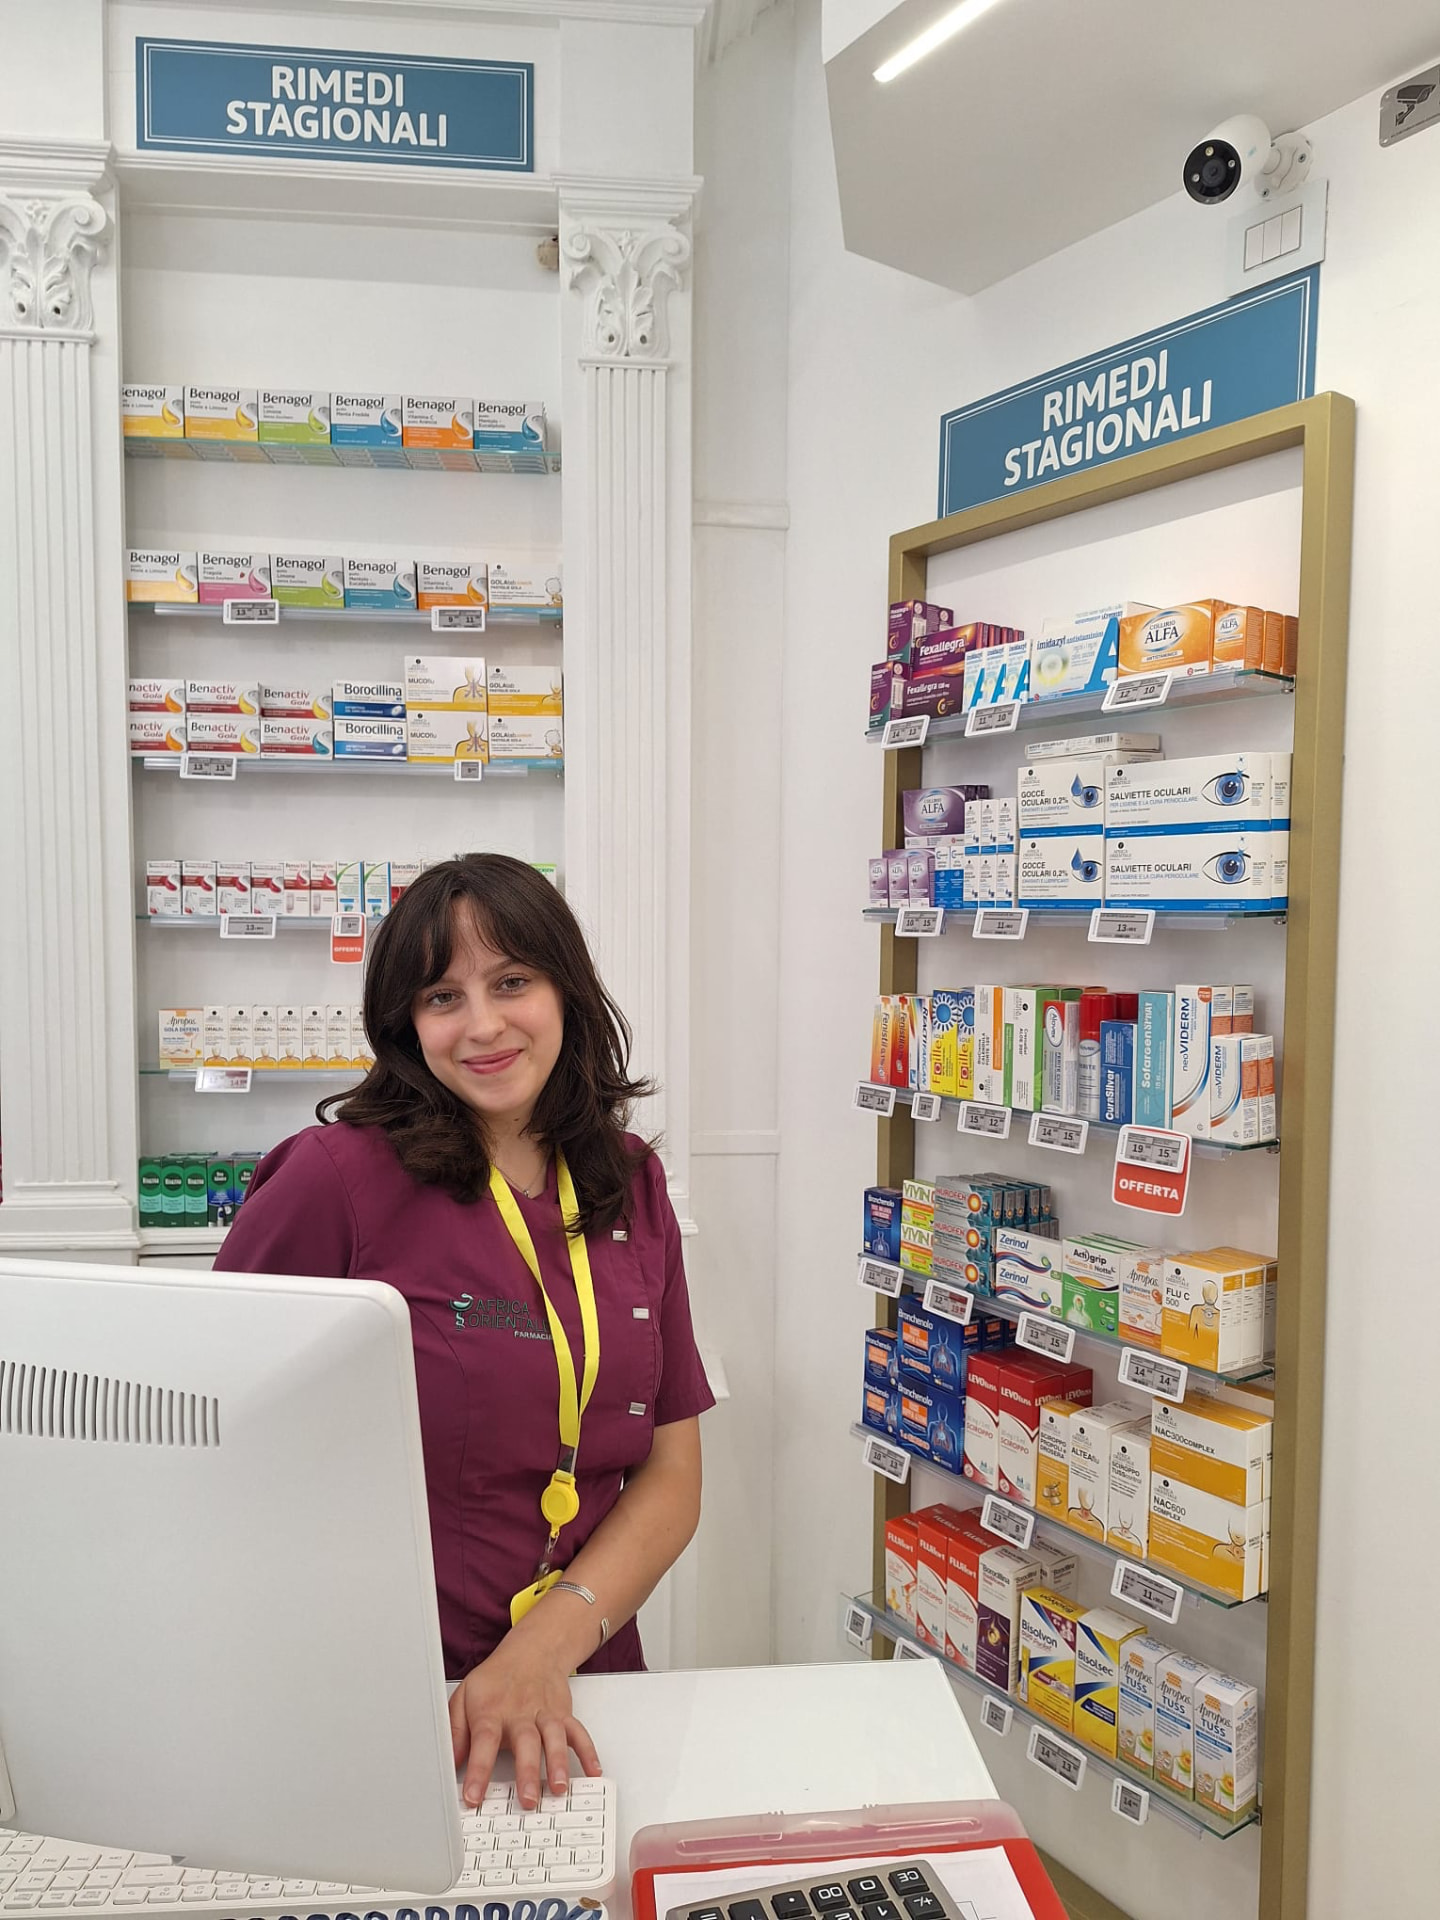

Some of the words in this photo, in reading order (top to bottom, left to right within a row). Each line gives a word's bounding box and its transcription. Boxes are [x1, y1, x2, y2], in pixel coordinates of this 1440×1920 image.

[271, 65, 404, 107] RIMEDI
[226, 102, 447, 147] STAGIONALI
[190, 388, 240, 403] Benagol
[1043, 350, 1167, 431] RIMEDI
[263, 393, 312, 406] Benagol
[336, 396, 384, 408] Benagol
[407, 399, 455, 411] Benagol
[479, 402, 526, 415] Benagol
[1004, 380, 1212, 486] STAGIONALI
[130, 552, 179, 565] Benagol
[203, 554, 252, 568] Benagol
[276, 557, 325, 571] Benagol
[349, 560, 396, 575] Benagol
[423, 565, 470, 579] Benagol
[1150, 620, 1175, 630] COLLIRIO
[1220, 620, 1238, 630] ALFA
[1145, 626, 1178, 644] ALFA
[920, 639, 964, 656] Fexallegra
[190, 684, 235, 693] Benactiv
[264, 689, 309, 699] Benactiv
[344, 684, 402, 696] Borocillina
[907, 684, 937, 694] Fexallegra
[1119, 690, 1130, 698] 12
[1144, 686, 1154, 694] 10
[191, 723, 237, 732] Benactiv
[264, 724, 309, 734] Benactiv
[346, 723, 403, 735] Borocillina
[1021, 790, 1045, 798] GOCCE
[1110, 790, 1151, 800] SALVIETTE
[1154, 787, 1190, 797] OCULARI
[922, 803, 944, 814] ALFA
[1021, 798, 1051, 806] OCULARI
[1053, 797, 1068, 805] 0,2%
[1053, 869, 1069, 877] 0,2%
[1111, 864, 1152, 873] SALVIETTE
[1155, 863, 1191, 871] OCULARI
[1117, 924, 1127, 932] 13
[1050, 1013, 1058, 1038] Alovex
[1180, 998, 1190, 1072] neoVIDERM
[1042, 1128, 1051, 1136] 14
[1064, 1132, 1073, 1140] 15
[1133, 1144, 1143, 1153] 19
[1158, 1148, 1169, 1157] 15
[904, 1183, 929, 1202] VIVIN
[936, 1189, 966, 1201] NUROFEN
[1119, 1178, 1179, 1200] OFFERTA
[902, 1225, 929, 1246] VIVIN
[934, 1222, 965, 1236] NUROFEN
[1000, 1234, 1028, 1250] Zerinol
[934, 1255, 964, 1270] NUROFEN
[1000, 1267, 1029, 1284] Zerinol
[935, 1295, 943, 1303] 12
[1167, 1287, 1181, 1298] FLU
[476, 1299, 530, 1316] AFRICA
[1166, 1298, 1179, 1307] 500
[898, 1309, 933, 1330] Bronchenolo
[1030, 1330, 1039, 1339] 13
[1050, 1338, 1060, 1348] 15
[968, 1373, 997, 1392] LEVOtuss
[1135, 1366, 1145, 1376] 14
[1160, 1375, 1170, 1385] 14
[898, 1383, 932, 1406] Bronchenolo
[1001, 1386, 1031, 1406] LEVOtuss
[967, 1423, 993, 1439] SCIROPPO
[1001, 1437, 1029, 1454] SCIROPPO
[1041, 1432, 1066, 1447] SCIROPPO
[1041, 1439, 1062, 1452] PROPOLI
[1155, 1426, 1215, 1454] NAC300COMPLEX
[1112, 1461, 1140, 1476] SCIROPPO
[1153, 1506, 1181, 1521] COMPLEX
[1154, 1496, 1186, 1516] NAC600
[1015, 1525, 1020, 1533] 9
[983, 1563, 1010, 1584] Borocillina
[919, 1585, 943, 1604] SCIROPPO
[949, 1604, 974, 1624] SCIROPPO
[1021, 1619, 1058, 1648] Bisolvon
[1077, 1650, 1114, 1676] Bisolsec
[1121, 1661, 1153, 1684] Apropos
[1125, 1676, 1147, 1693] TUSS
[1157, 1681, 1192, 1705] Apropos
[1162, 1696, 1185, 1714] TUSS
[1195, 1703, 1232, 1728] Apropos
[1201, 1719, 1226, 1737] TUSS
[1041, 1749, 1051, 1758] 14
[1062, 1760, 1072, 1772] 13
[1123, 1798, 1132, 1807] 14
[898, 1870, 919, 1882] CE
[819, 1887, 842, 1899] 00
[860, 1880, 876, 1891] 0
